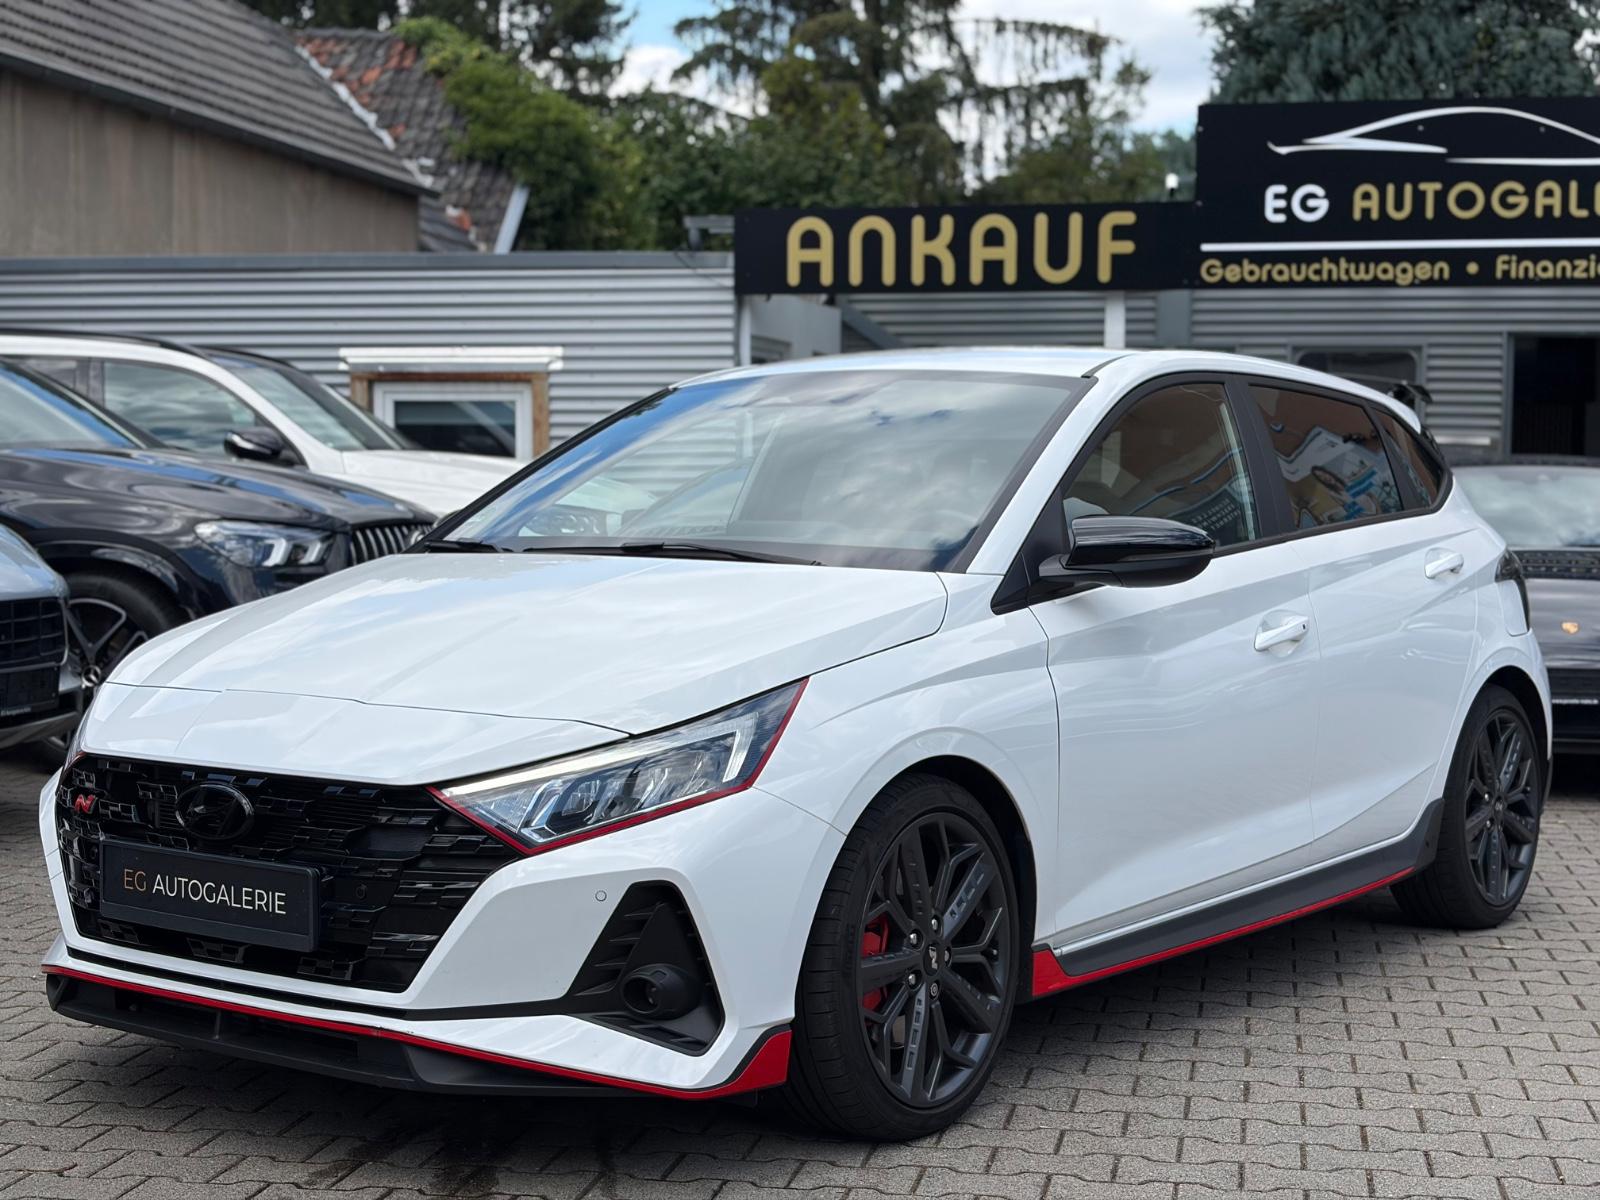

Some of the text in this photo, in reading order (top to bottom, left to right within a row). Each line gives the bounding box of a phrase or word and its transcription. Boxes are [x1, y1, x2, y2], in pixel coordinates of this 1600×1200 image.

[1264, 180, 1600, 223] EG AUTOGAL
[786, 211, 1137, 287] ANKAUF
[1200, 254, 1600, 286] Gebrauchtwagen Finanzi
[75, 794, 97, 814] N
[124, 869, 286, 914] EG AUTOGALERIE
